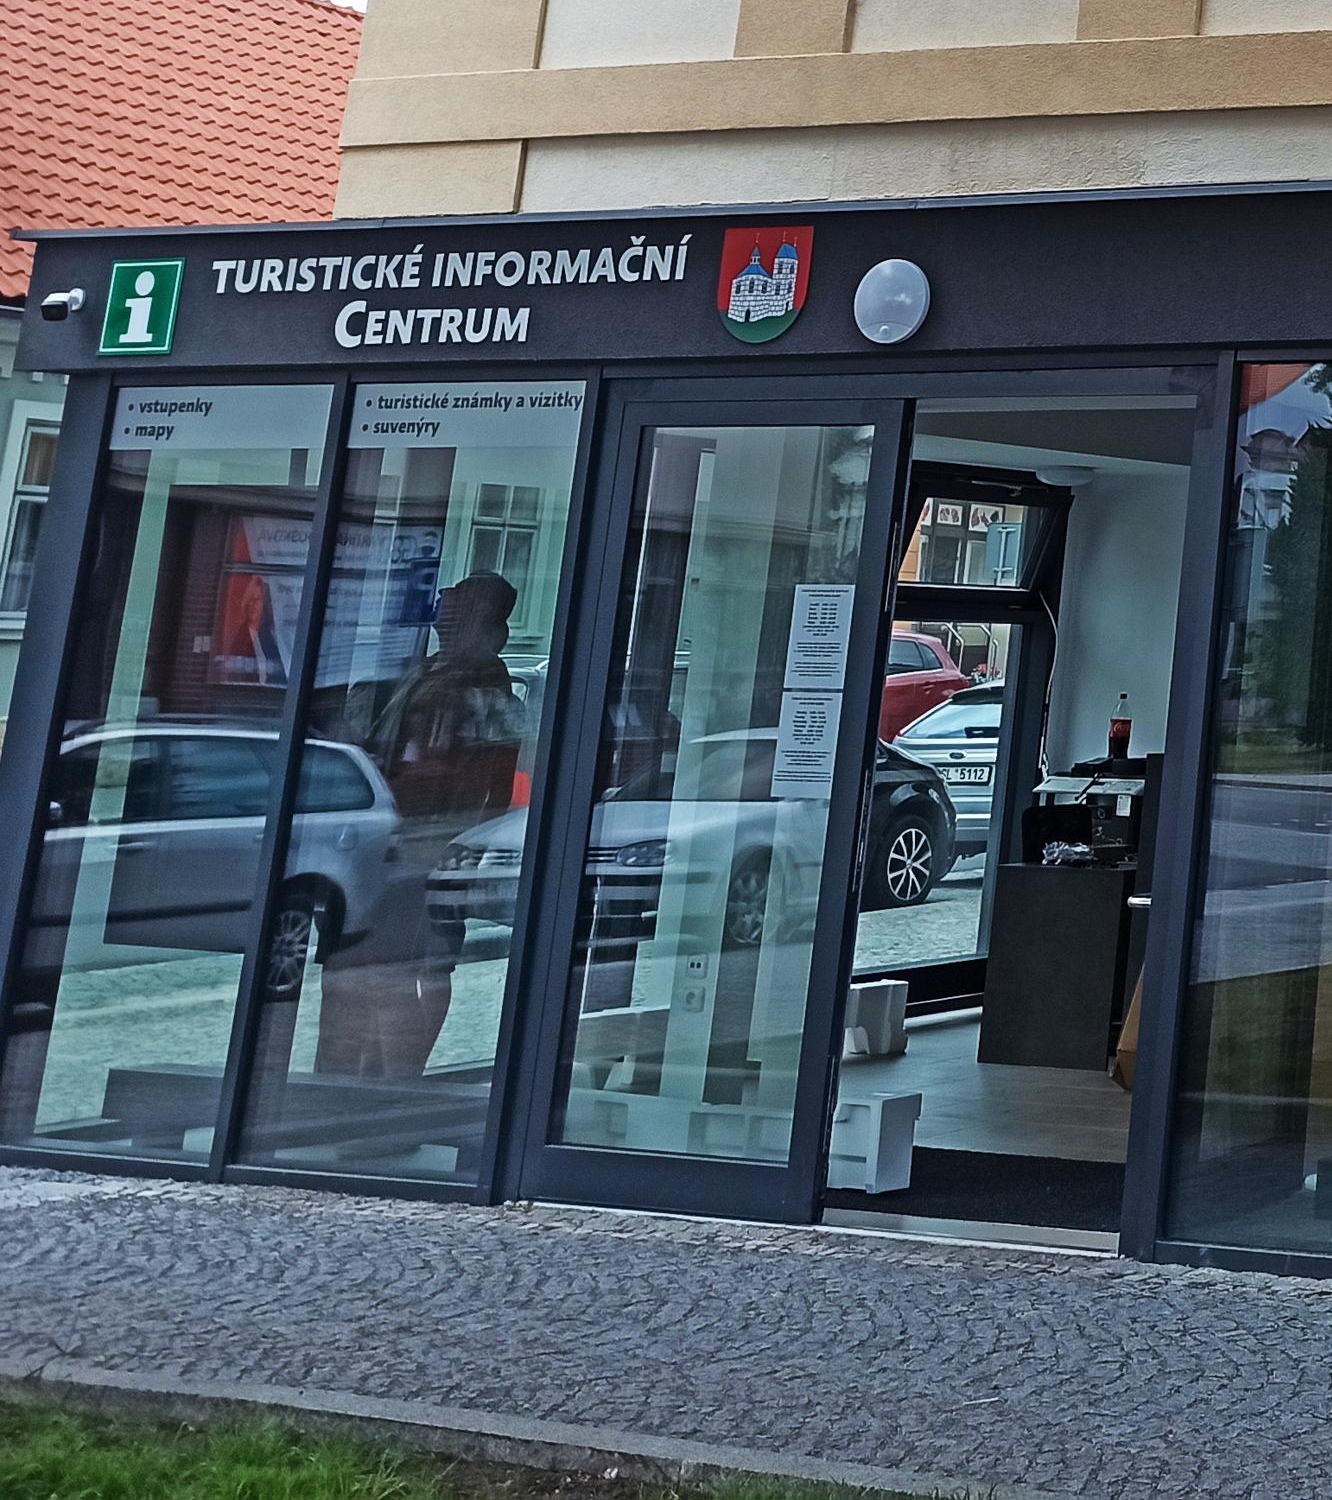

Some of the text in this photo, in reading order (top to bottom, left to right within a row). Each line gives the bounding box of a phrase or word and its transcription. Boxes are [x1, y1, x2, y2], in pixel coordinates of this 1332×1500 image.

[212, 233, 693, 294] TURISTICKÉ INFORMAČNÍ
[334, 300, 530, 348] CENTRUM
[139, 397, 213, 417] vstupenky
[378, 391, 583, 412] turistické známky a vizitky
[135, 425, 175, 440] mapy
[373, 417, 441, 437] suvenýry
[959, 768, 985, 780] 5112
